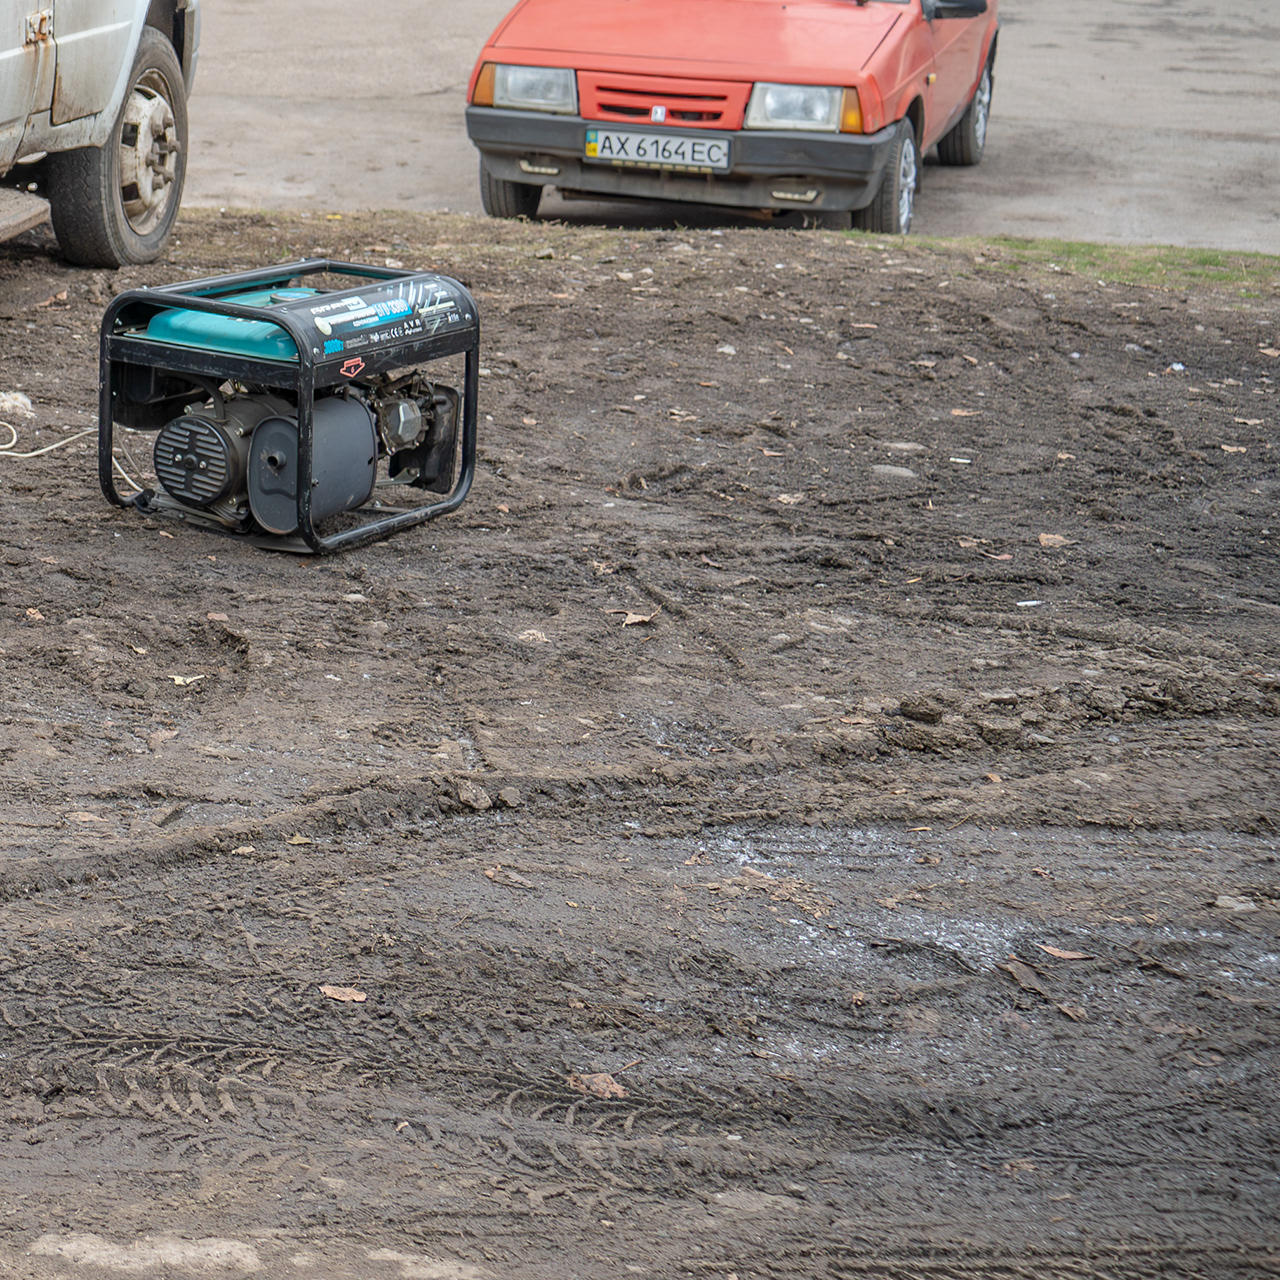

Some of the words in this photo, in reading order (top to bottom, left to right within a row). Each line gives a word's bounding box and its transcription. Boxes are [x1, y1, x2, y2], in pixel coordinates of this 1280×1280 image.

[600, 136, 630, 156] AX
[636, 138, 686, 161] 6164
[691, 142, 722, 163] EC
